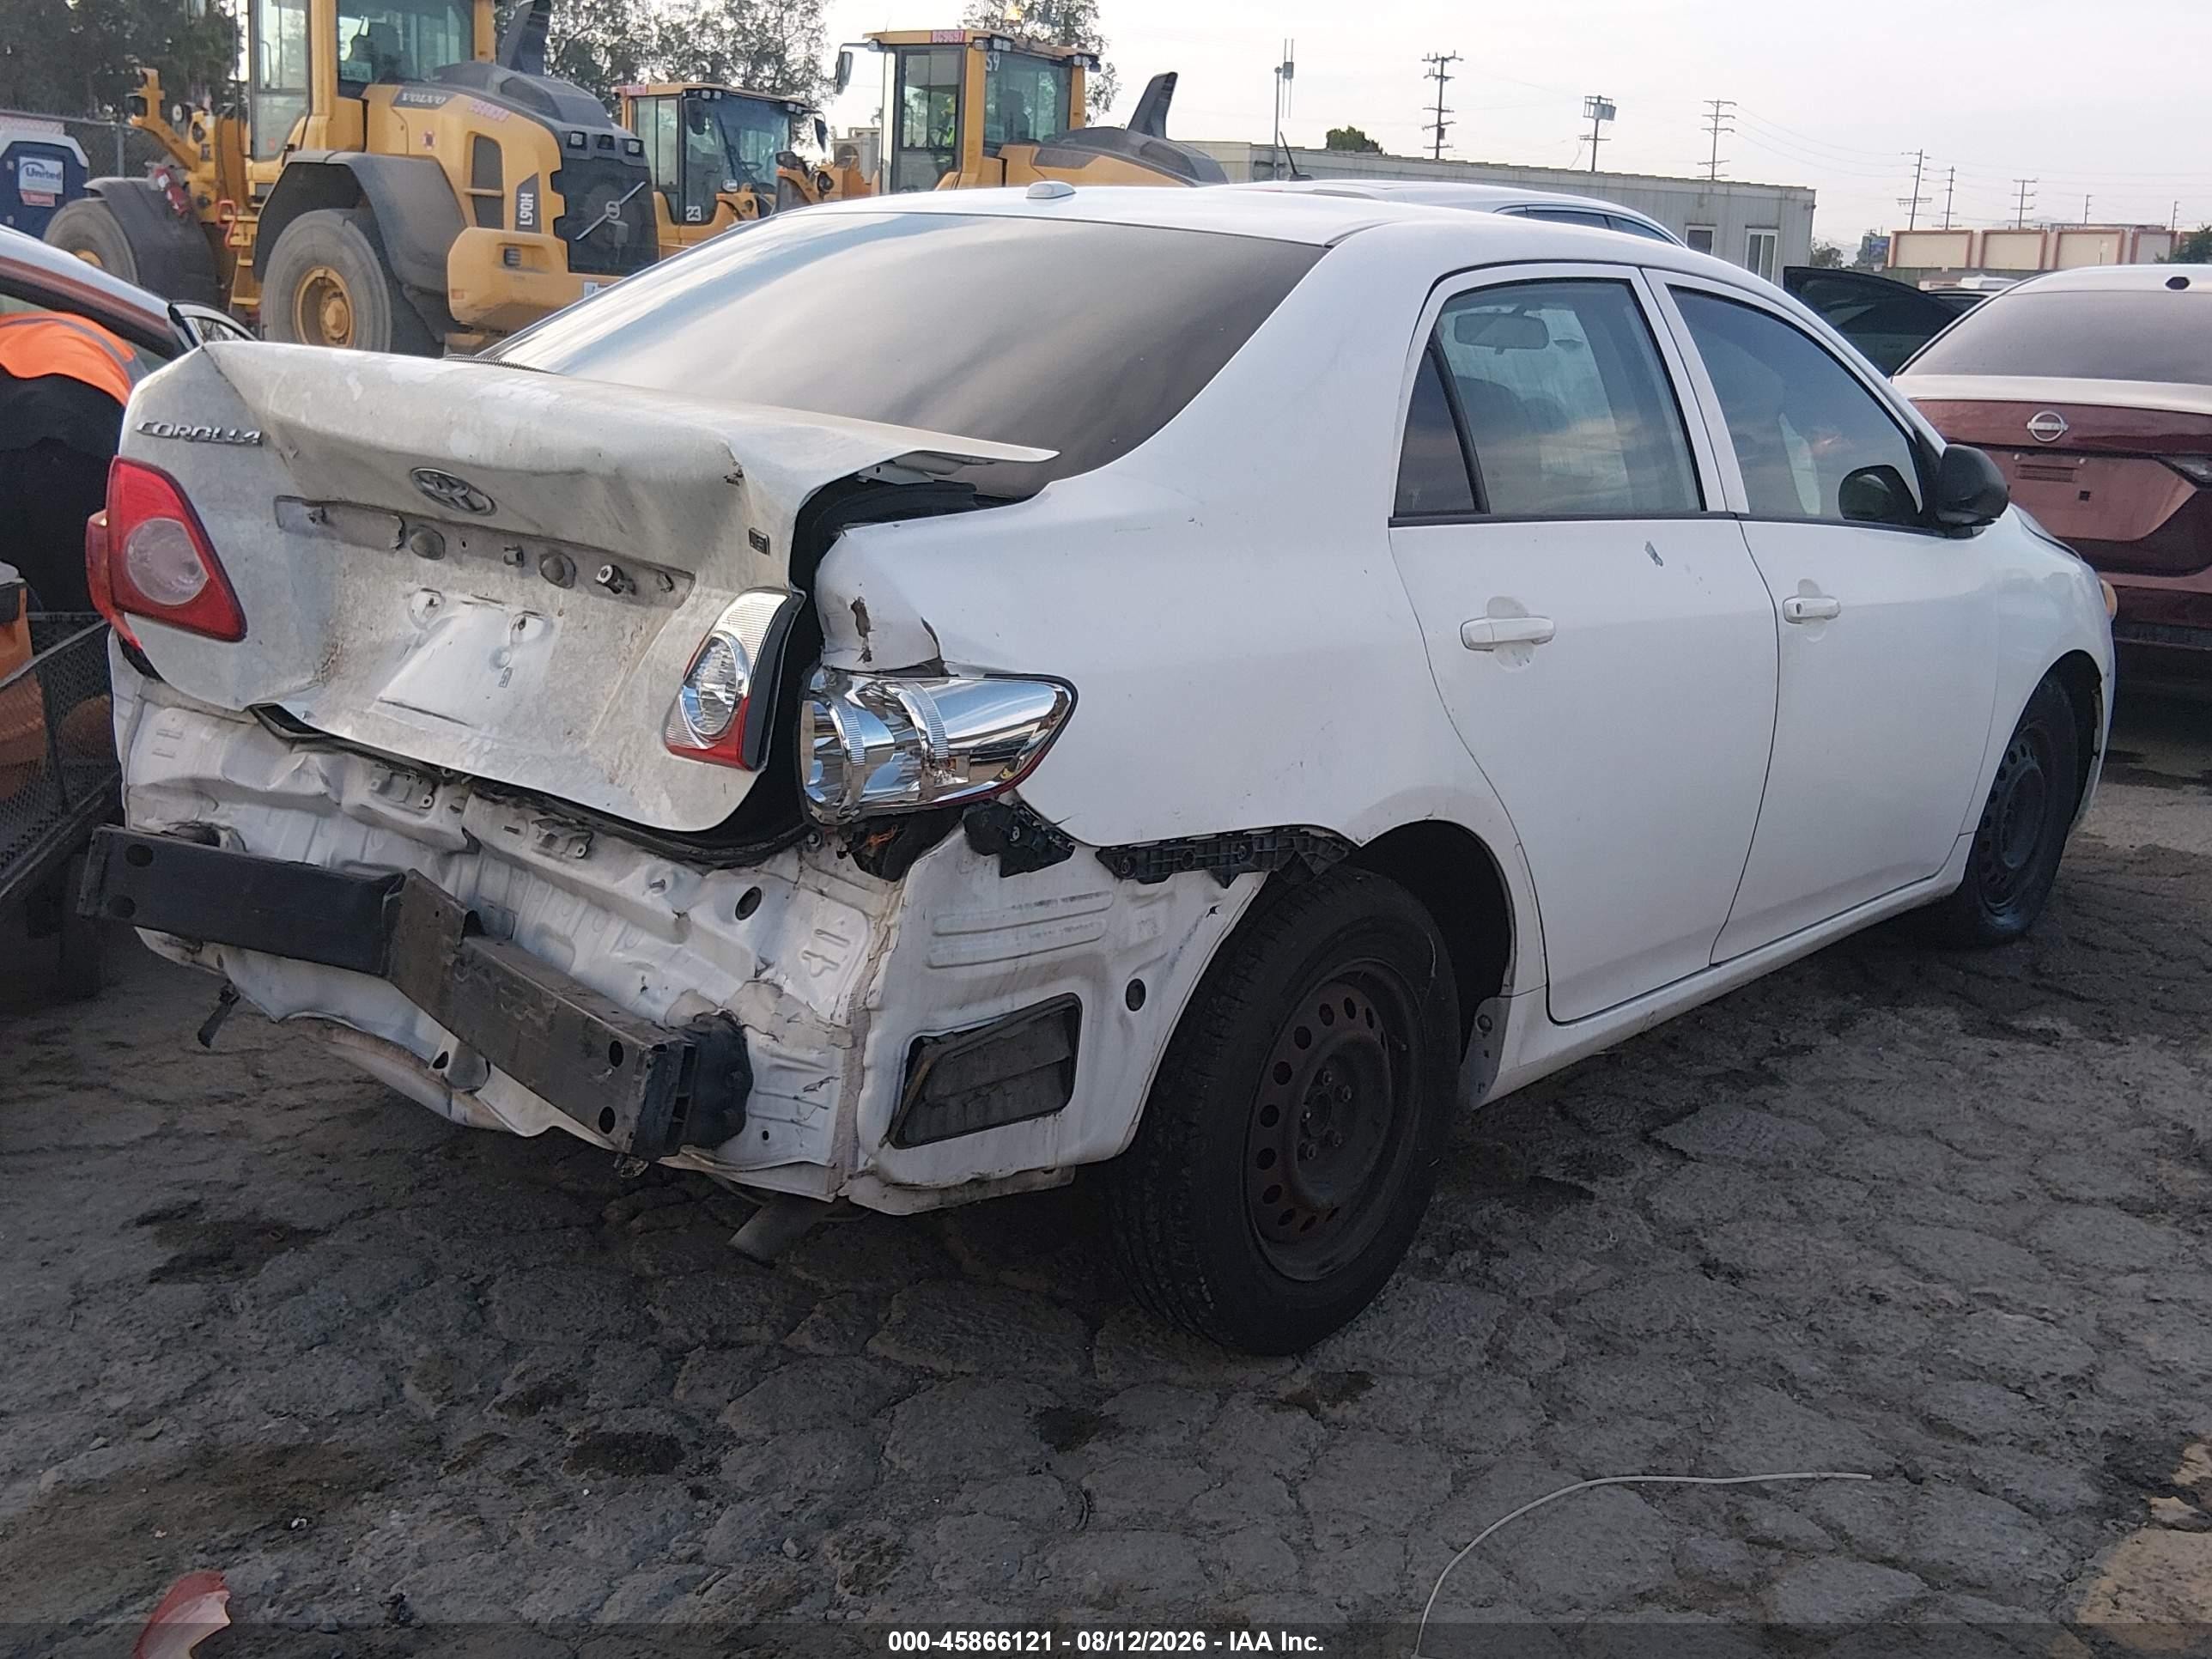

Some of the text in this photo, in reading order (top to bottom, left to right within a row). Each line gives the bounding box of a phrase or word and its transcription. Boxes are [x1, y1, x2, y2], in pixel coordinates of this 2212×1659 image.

[401, 92, 447, 104] VOLVO
[26, 166, 62, 181] United
[520, 192, 534, 226] L90H
[686, 206, 702, 221] 23
[137, 421, 263, 447] COROLLA
